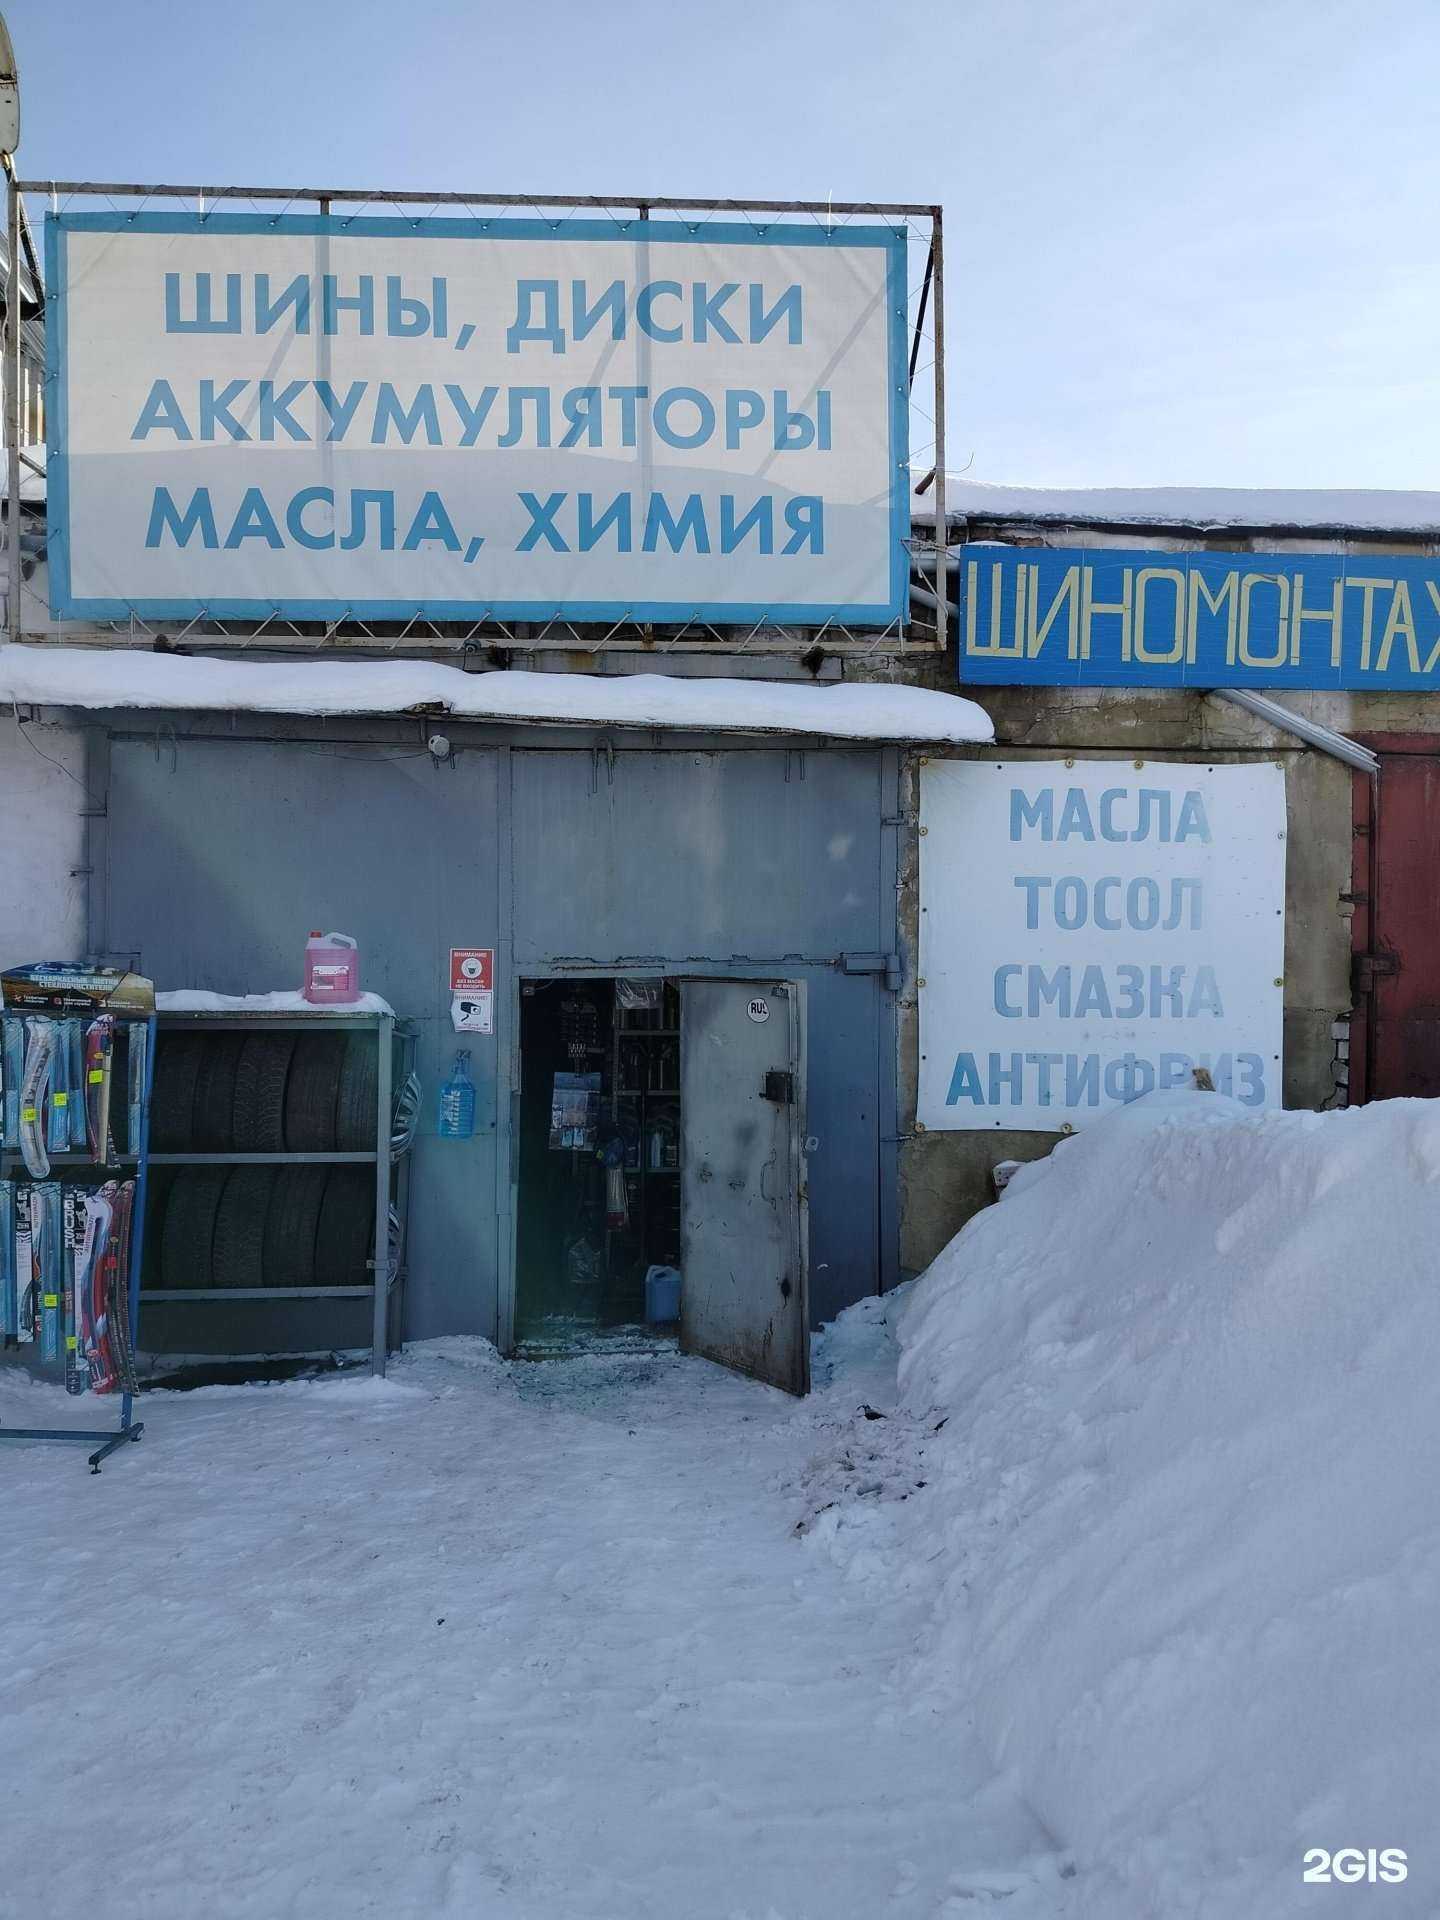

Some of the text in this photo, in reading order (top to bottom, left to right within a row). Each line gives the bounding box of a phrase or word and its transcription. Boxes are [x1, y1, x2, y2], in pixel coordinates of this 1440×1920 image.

[164, 273, 802, 354] ШИНЫ, ДИСКИ
[131, 379, 833, 452] АККУМУЛЯТОРЫ
[145, 486, 826, 564] МАСЛА, ХИМИЯ
[1009, 788, 1213, 843] МАСЛА
[1014, 876, 1204, 930] ТОСОЛ
[993, 964, 1224, 1019] СМАЗКА
